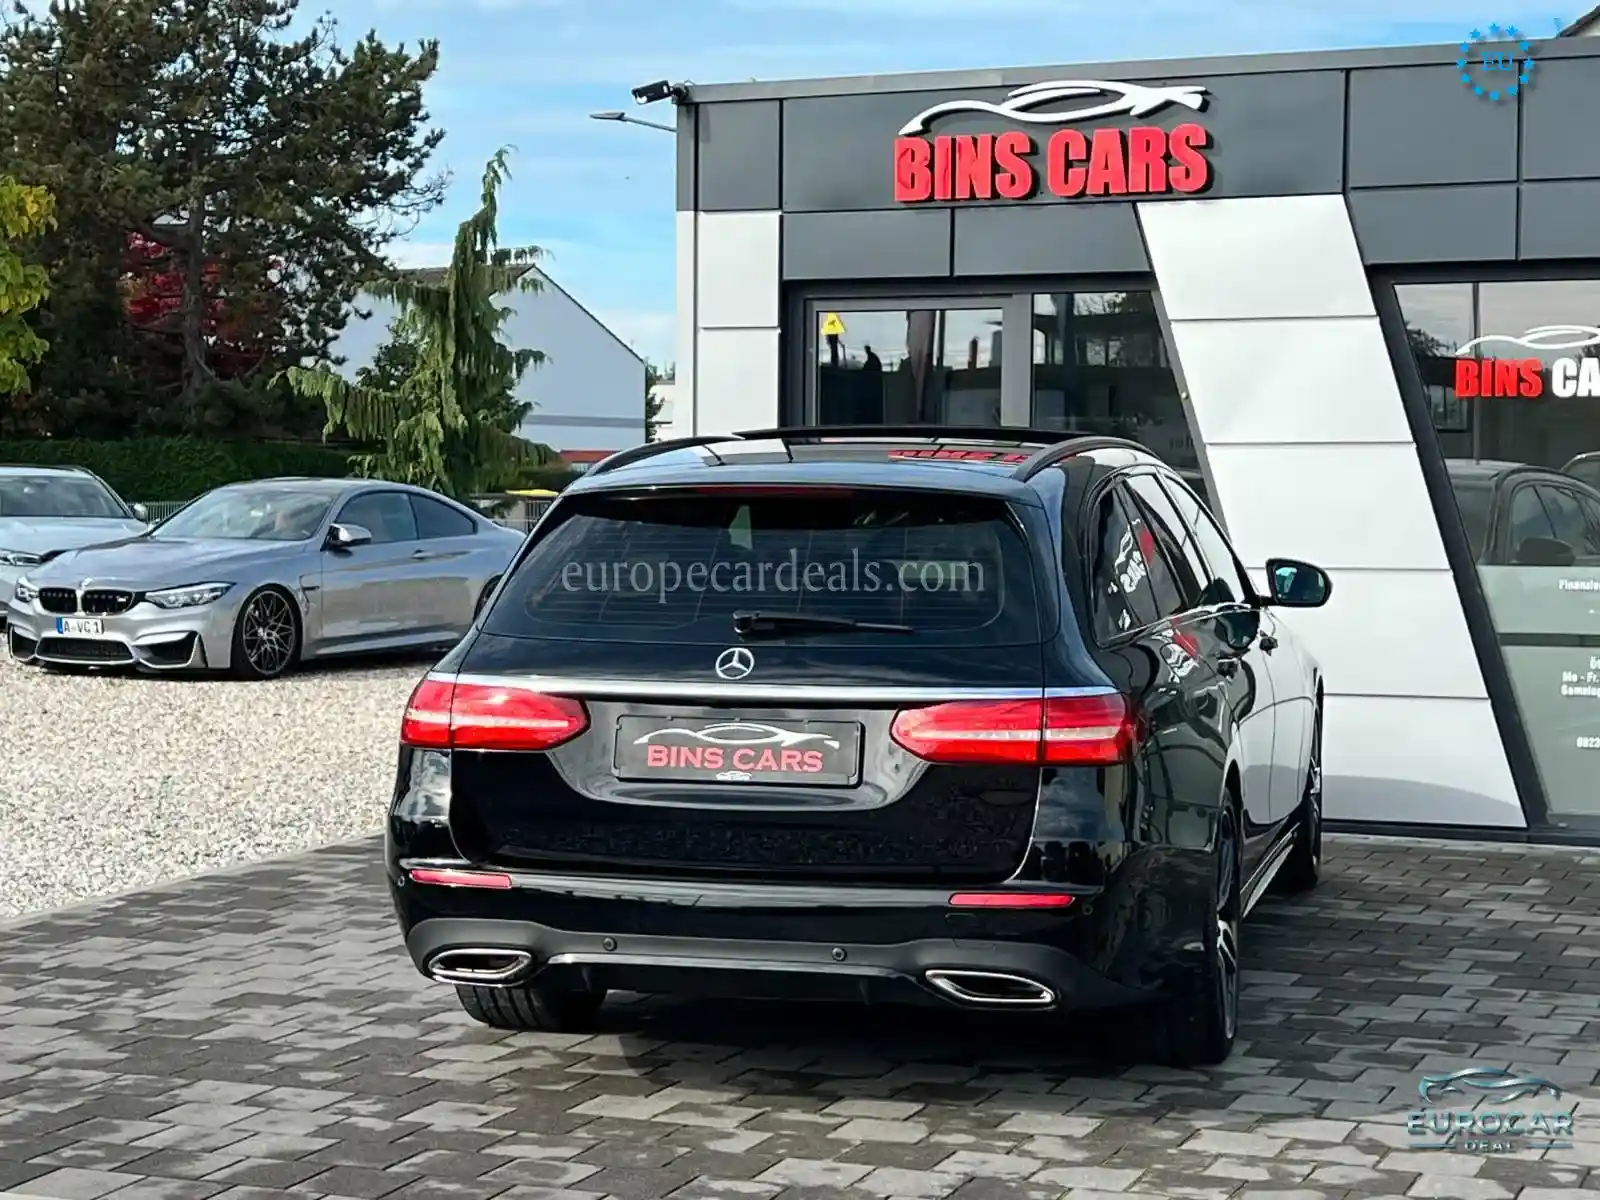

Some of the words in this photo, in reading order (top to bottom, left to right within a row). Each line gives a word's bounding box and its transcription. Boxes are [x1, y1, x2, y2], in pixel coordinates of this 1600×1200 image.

[894, 130, 1033, 202] BINS
[1047, 123, 1210, 197] CARS
[1455, 356, 1543, 398] BINS
[1552, 357, 1600, 398] CA
[1558, 579, 1600, 590] Finanzie
[647, 744, 723, 769] BINS
[733, 748, 823, 772] CARS
